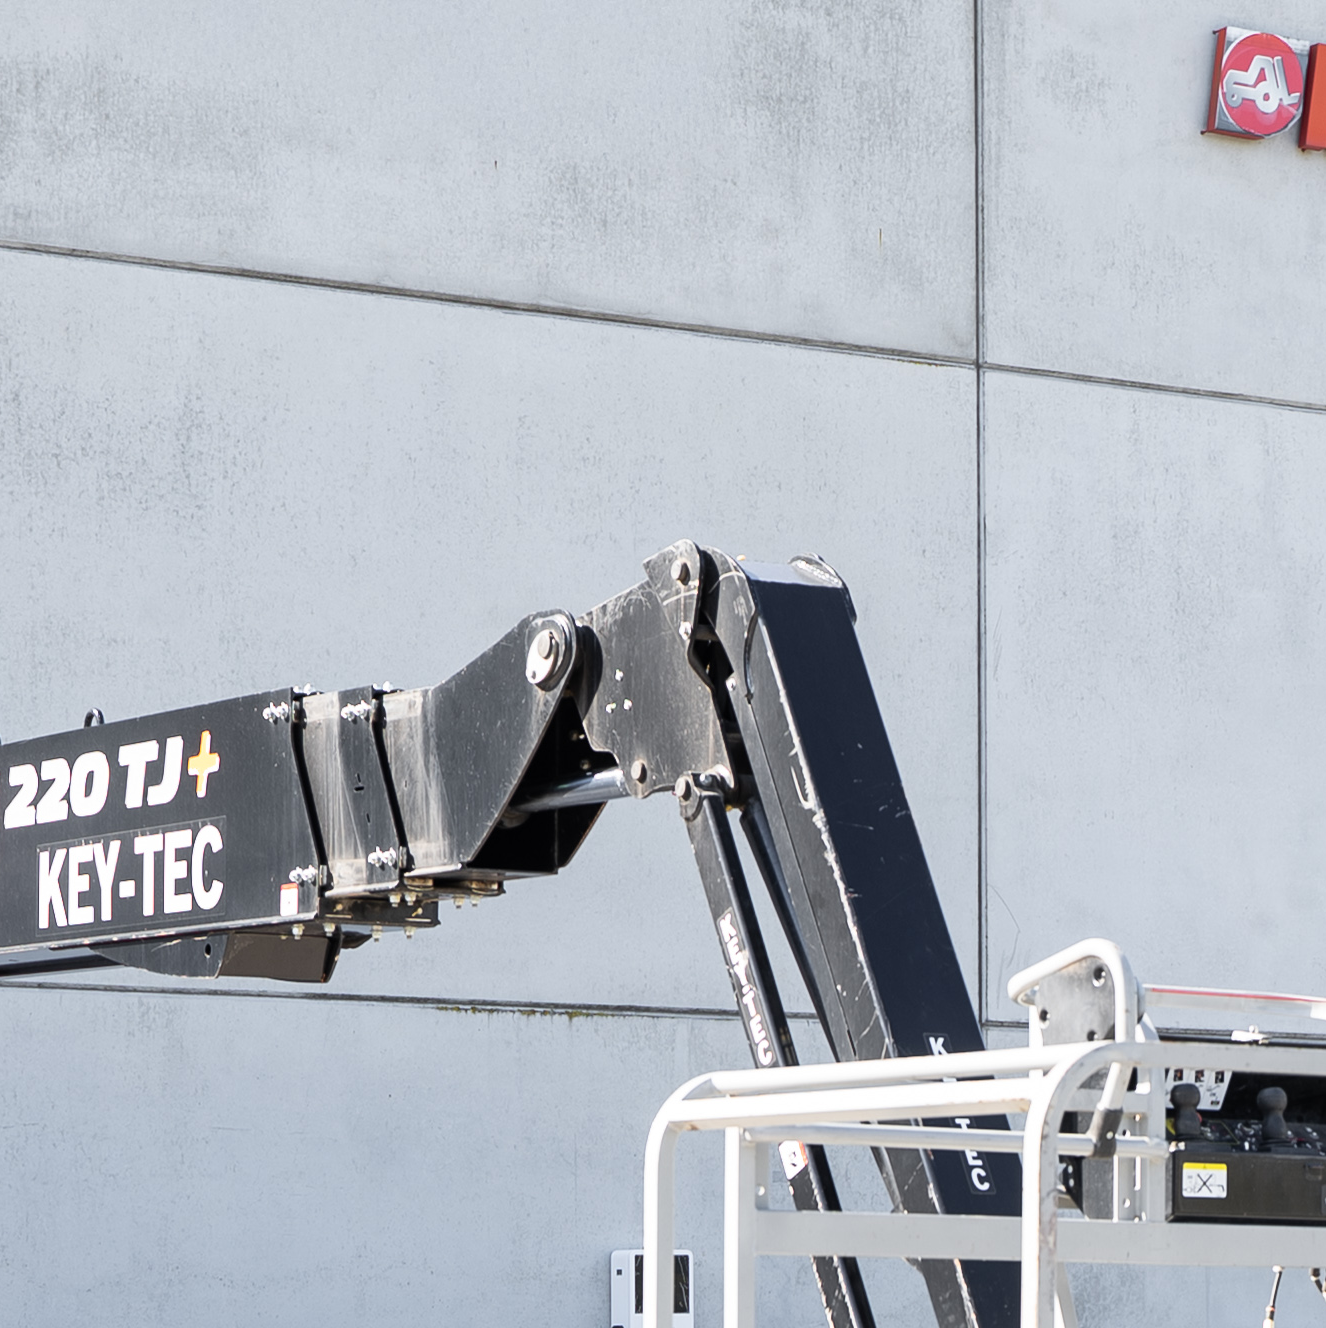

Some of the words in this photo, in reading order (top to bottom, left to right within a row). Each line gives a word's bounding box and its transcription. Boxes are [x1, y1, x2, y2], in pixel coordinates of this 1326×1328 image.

[3, 750, 110, 830] 220
[38, 824, 224, 930] KEY-TEC
[719, 913, 773, 1067] KEY-TEC
